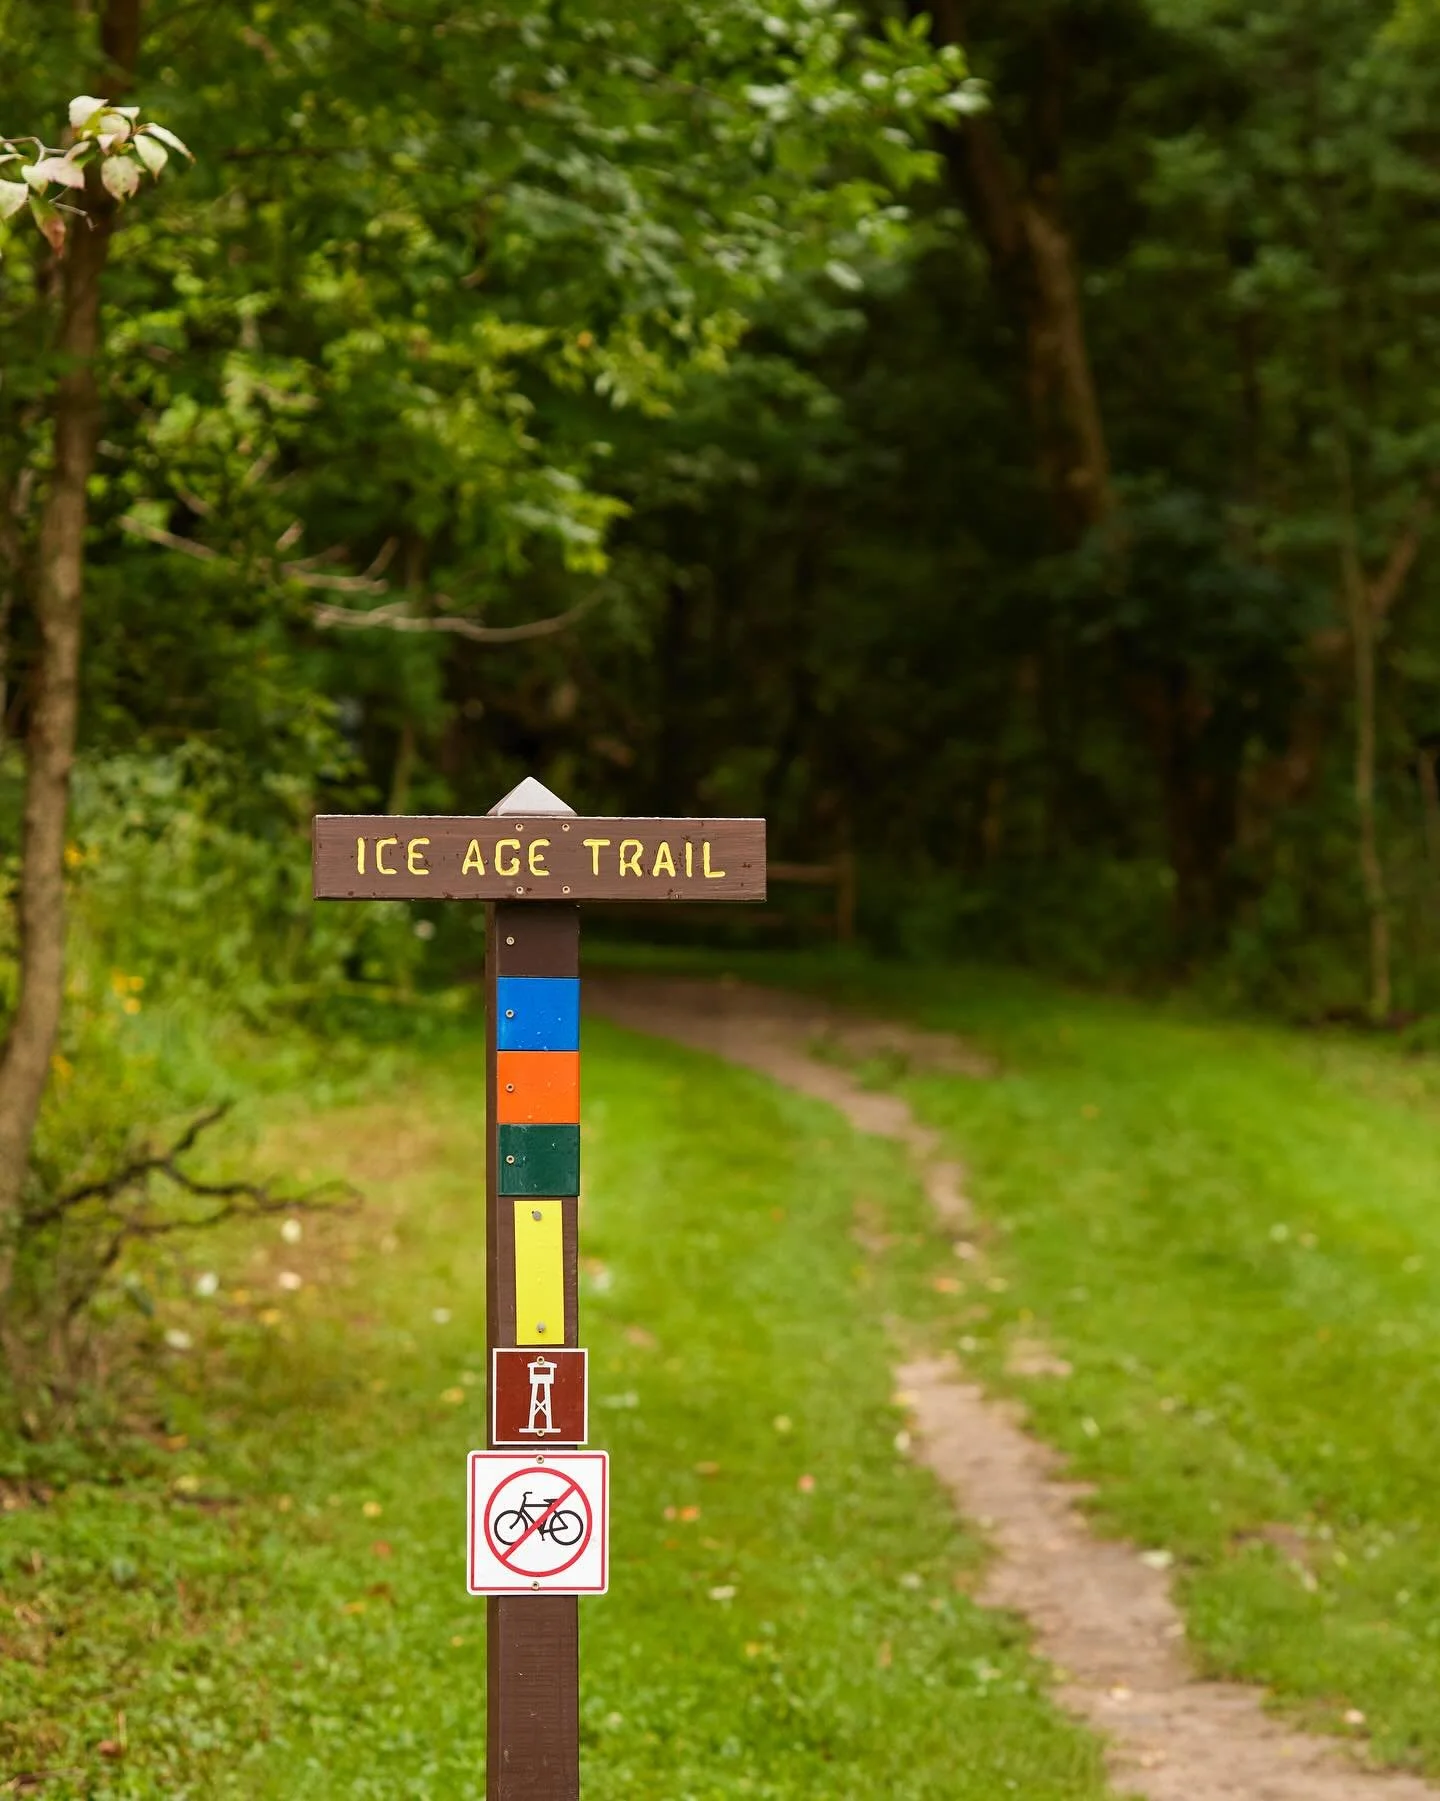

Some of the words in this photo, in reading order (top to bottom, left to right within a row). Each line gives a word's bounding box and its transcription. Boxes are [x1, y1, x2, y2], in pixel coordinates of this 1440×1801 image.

[356, 836, 431, 876] ICE
[461, 838, 552, 877] AGE
[582, 838, 727, 879] TRAIL
